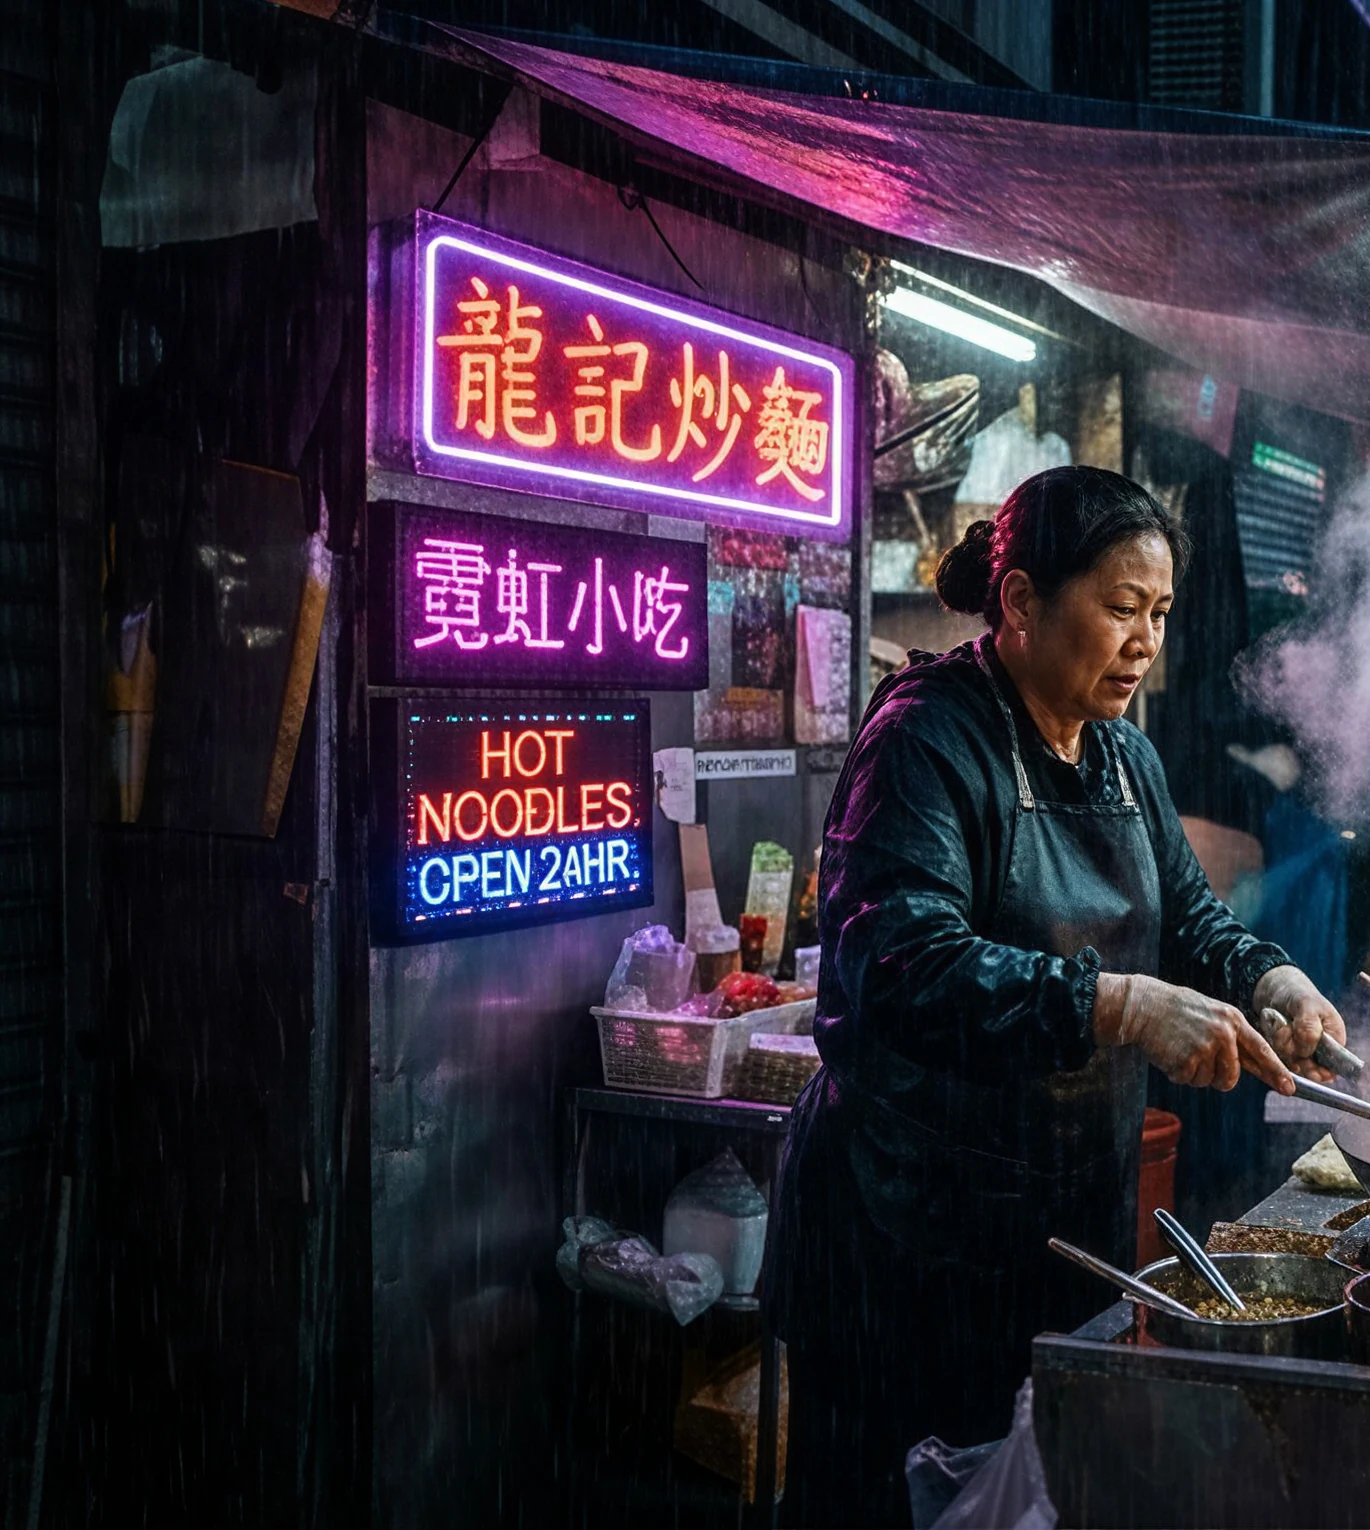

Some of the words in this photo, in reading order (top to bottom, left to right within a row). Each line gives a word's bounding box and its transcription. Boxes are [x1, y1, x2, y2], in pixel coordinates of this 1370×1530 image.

[437, 276, 828, 502] 龍記炒麵
[414, 538, 689, 659] 霓虹小吃
[481, 730, 574, 778] HOT
[417, 781, 632, 845] NOODLES
